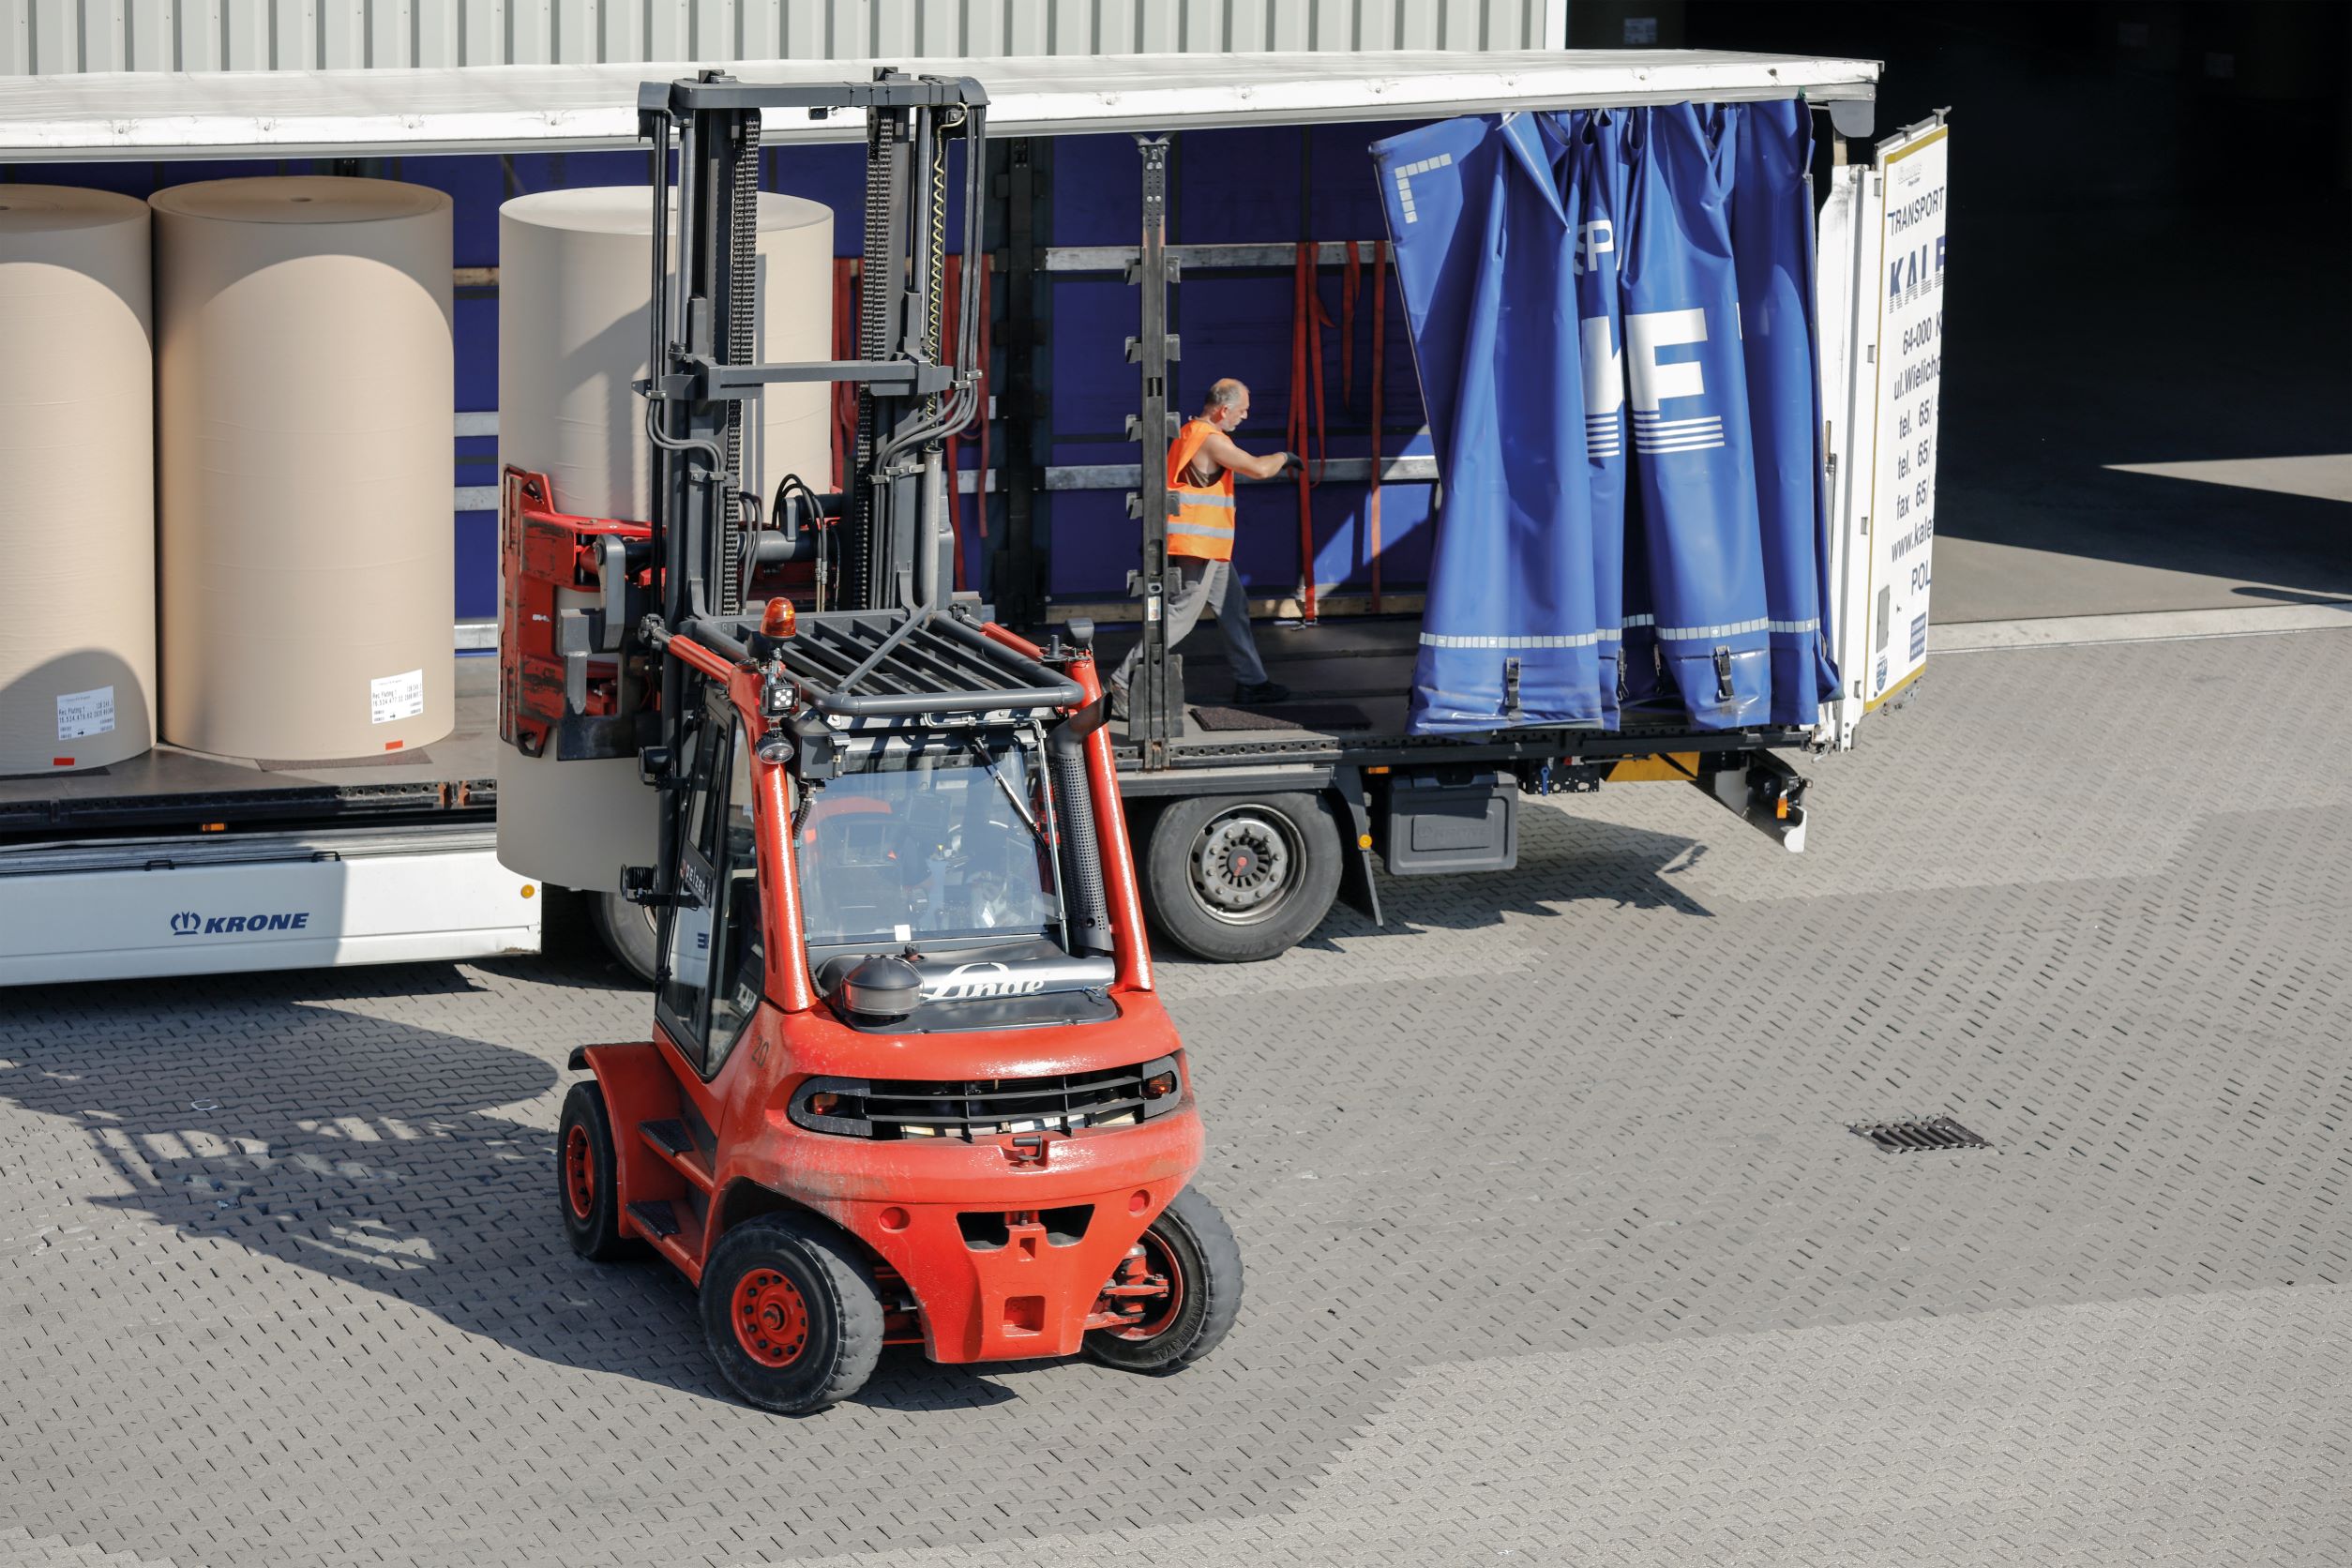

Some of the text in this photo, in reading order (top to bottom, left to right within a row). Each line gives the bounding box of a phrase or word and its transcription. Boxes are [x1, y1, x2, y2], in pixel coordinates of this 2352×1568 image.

[1887, 186, 1944, 236] TRANSPORT
[1903, 316, 1932, 356] 64-000
[1899, 394, 1933, 441] tel. 65/
[1898, 434, 1932, 481] tel. 65/
[1896, 475, 1930, 521] fax 65/
[1892, 516, 1933, 563] www.kale
[204, 912, 309, 934] KRONE
[919, 962, 1045, 1001] Linde
